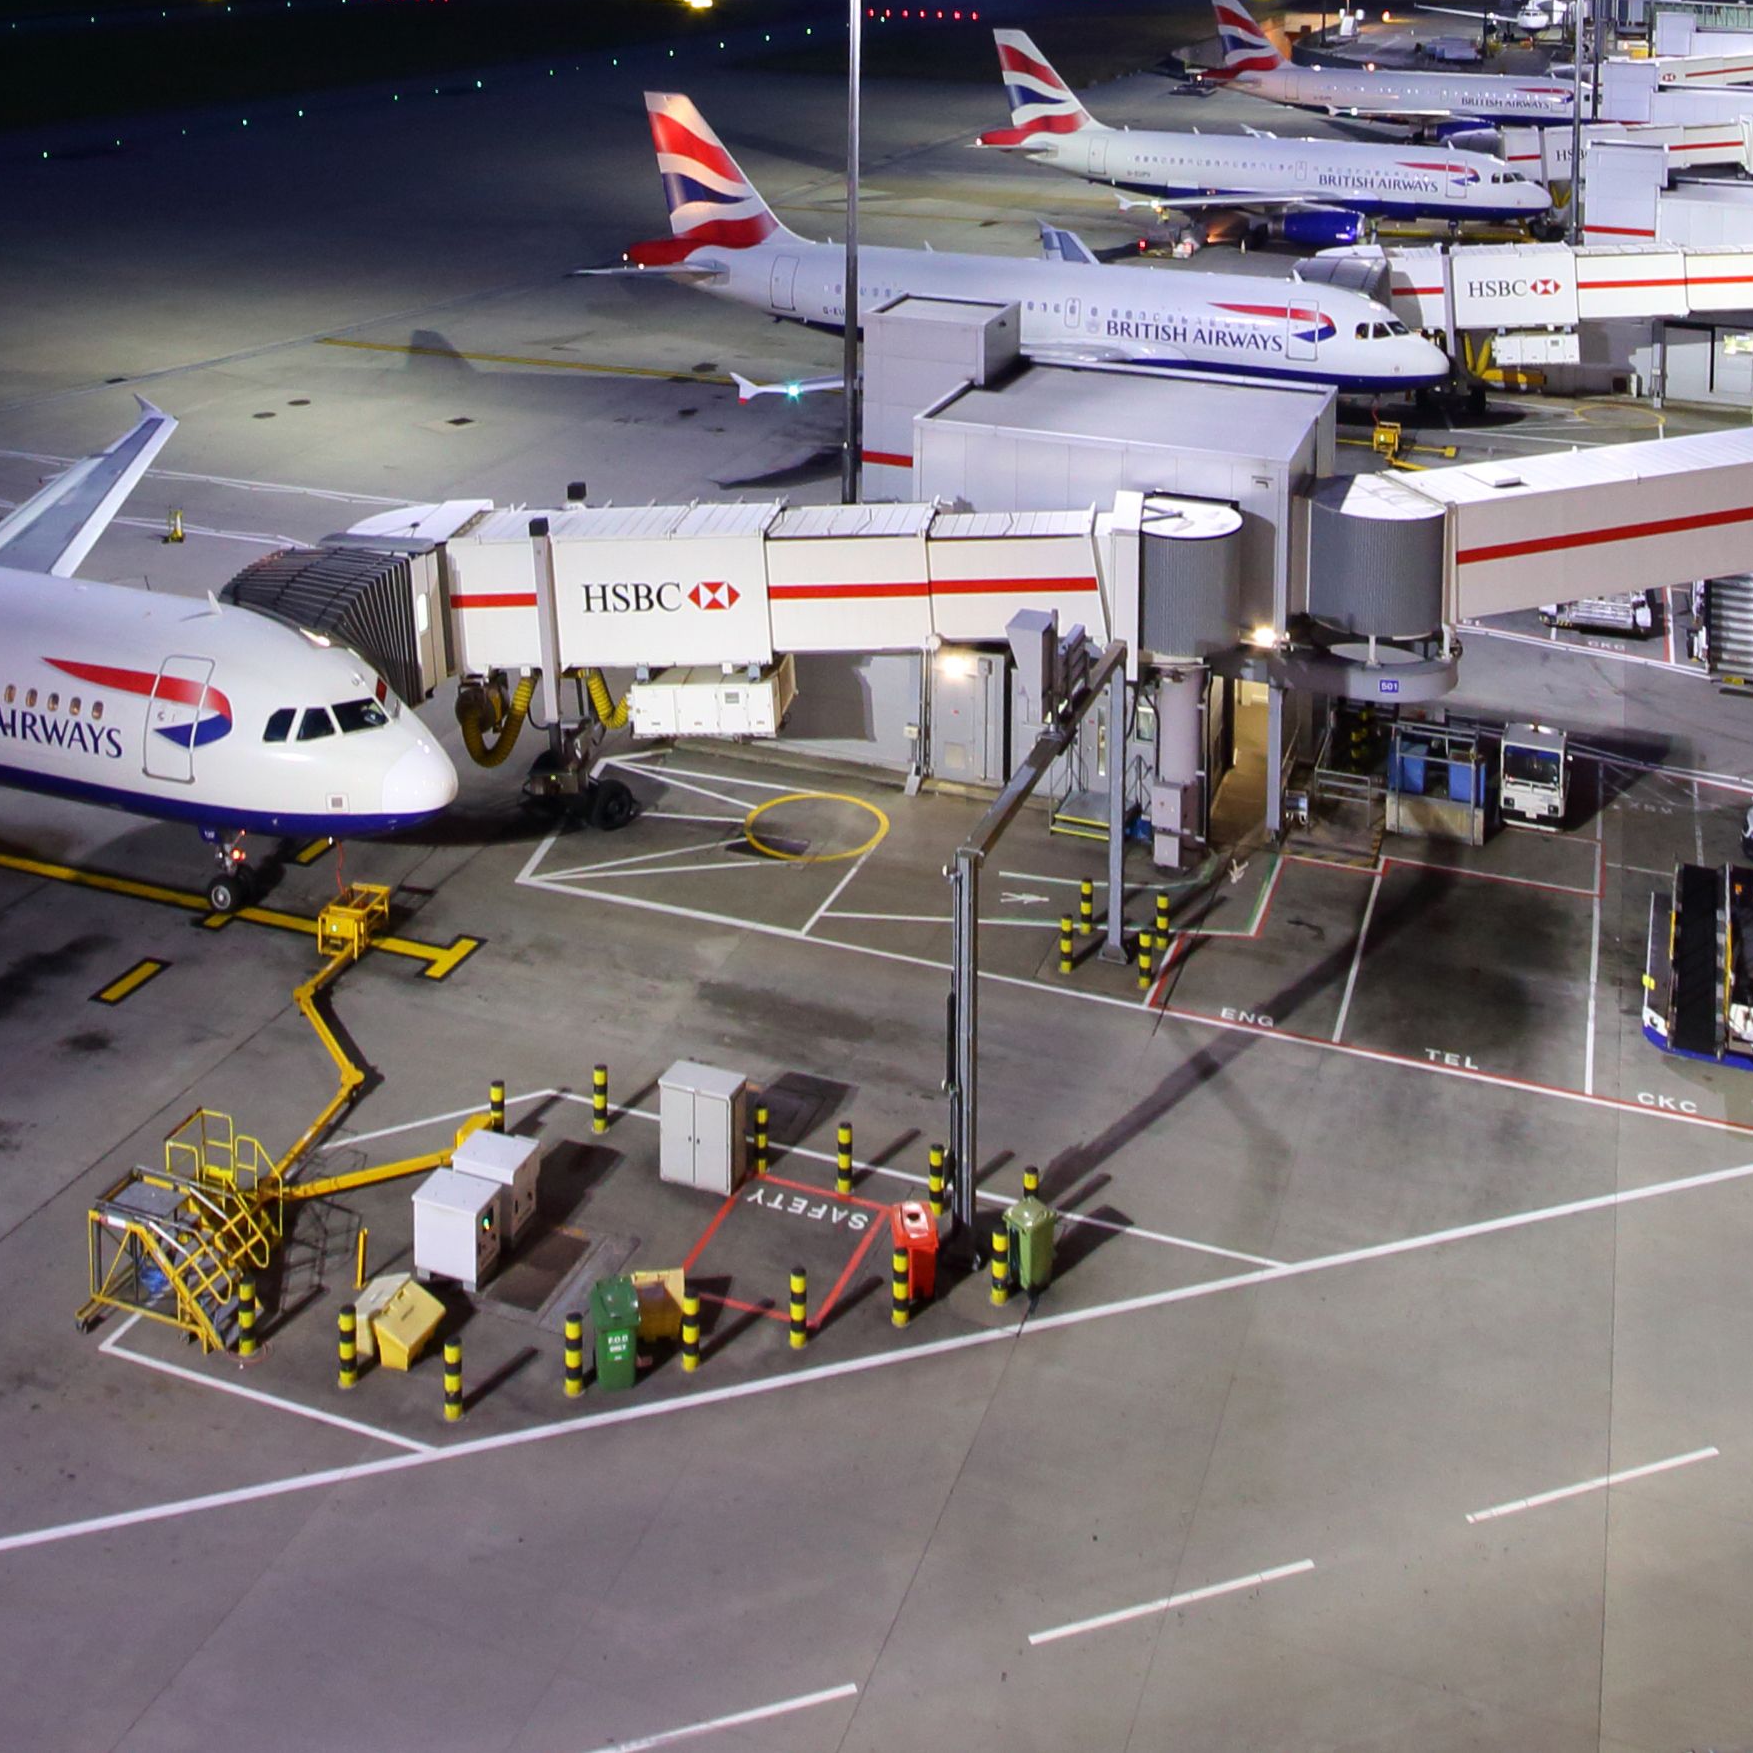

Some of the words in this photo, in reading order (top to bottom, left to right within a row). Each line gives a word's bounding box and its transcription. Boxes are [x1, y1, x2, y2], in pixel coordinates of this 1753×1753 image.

[1462, 97, 1503, 107] BRITISH
[1505, 100, 1550, 110] AIRWAYS
[1319, 174, 1374, 188] BRITISH
[1378, 178, 1438, 192] AIRWAYS
[1468, 280, 1527, 298] HSBC
[1107, 320, 1187, 343] BRITISH
[1193, 328, 1283, 352] AIRWAYS
[581, 582, 682, 613] HSBC
[1221, 1008, 1274, 1028] ENG
[1425, 1049, 1479, 1071] TEL
[1637, 1093, 1699, 1114] CKC
[747, 1188, 868, 1229] SAFETY
